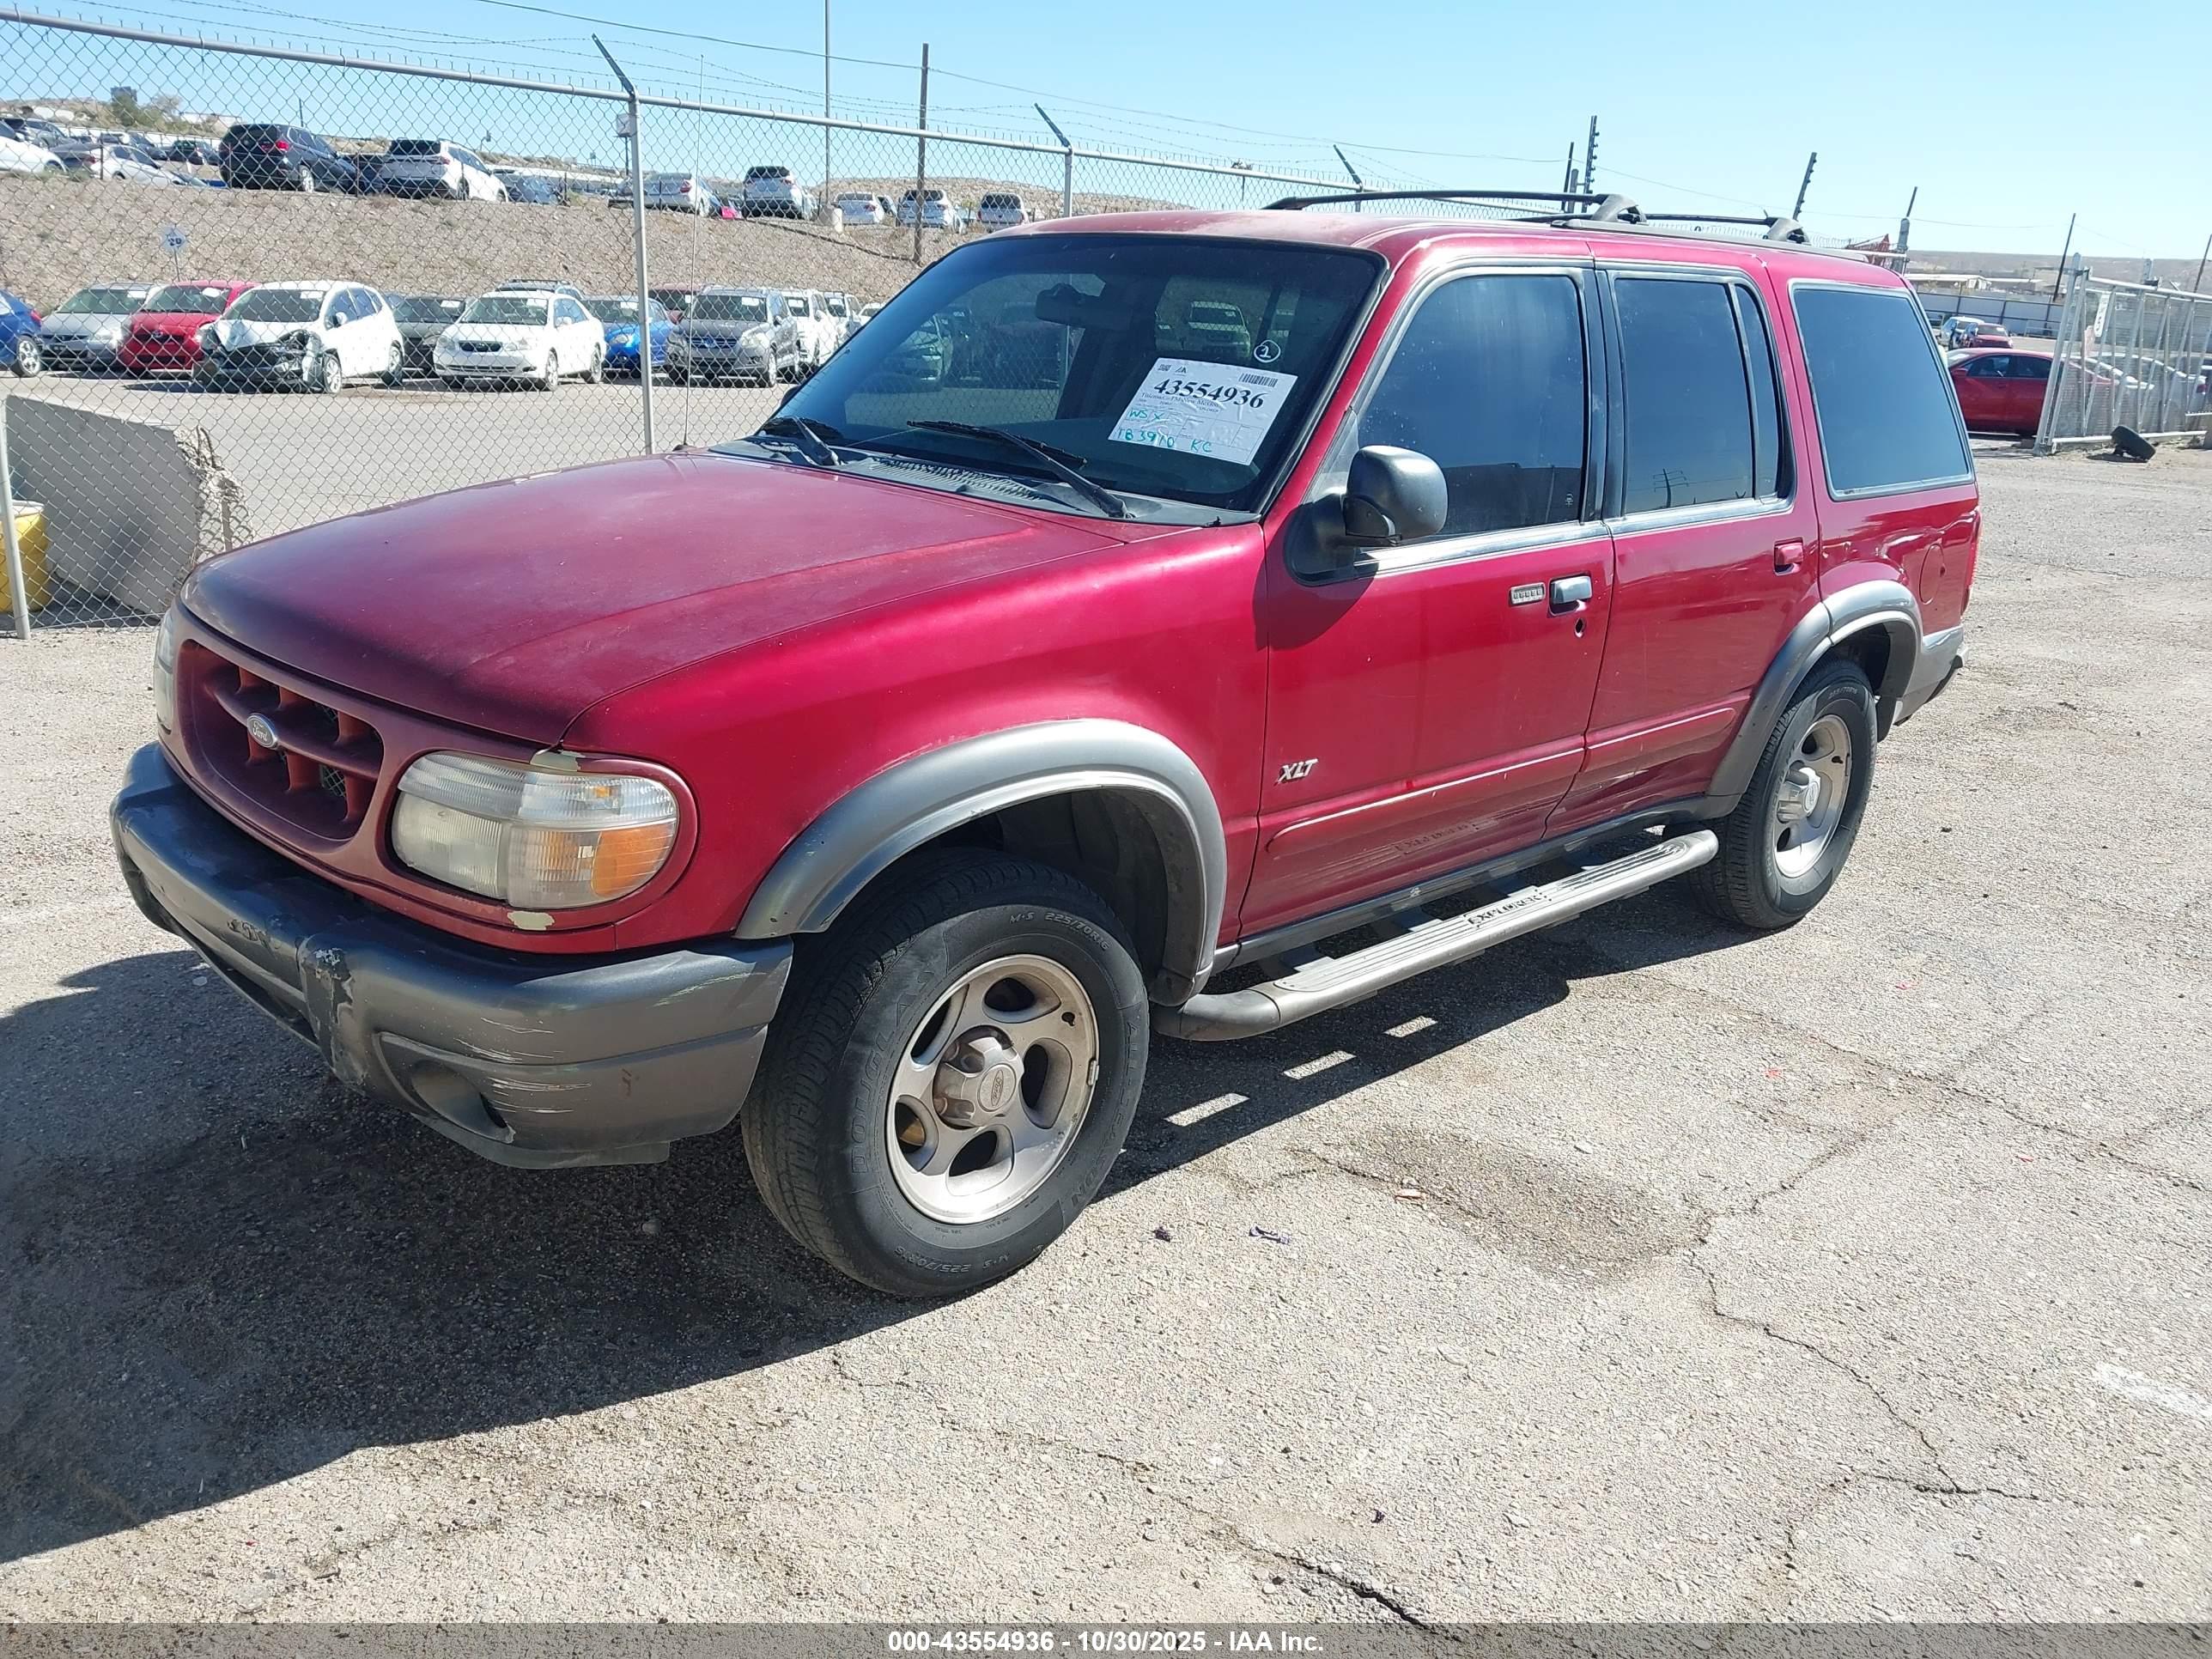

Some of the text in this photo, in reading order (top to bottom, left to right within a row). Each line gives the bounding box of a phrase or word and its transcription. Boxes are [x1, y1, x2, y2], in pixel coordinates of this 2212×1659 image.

[1154, 379, 1269, 409] 43554936
[252, 720, 269, 742] Ford
[1277, 757, 1319, 784] XLT
[1045, 912, 1109, 951] 225/70R16
